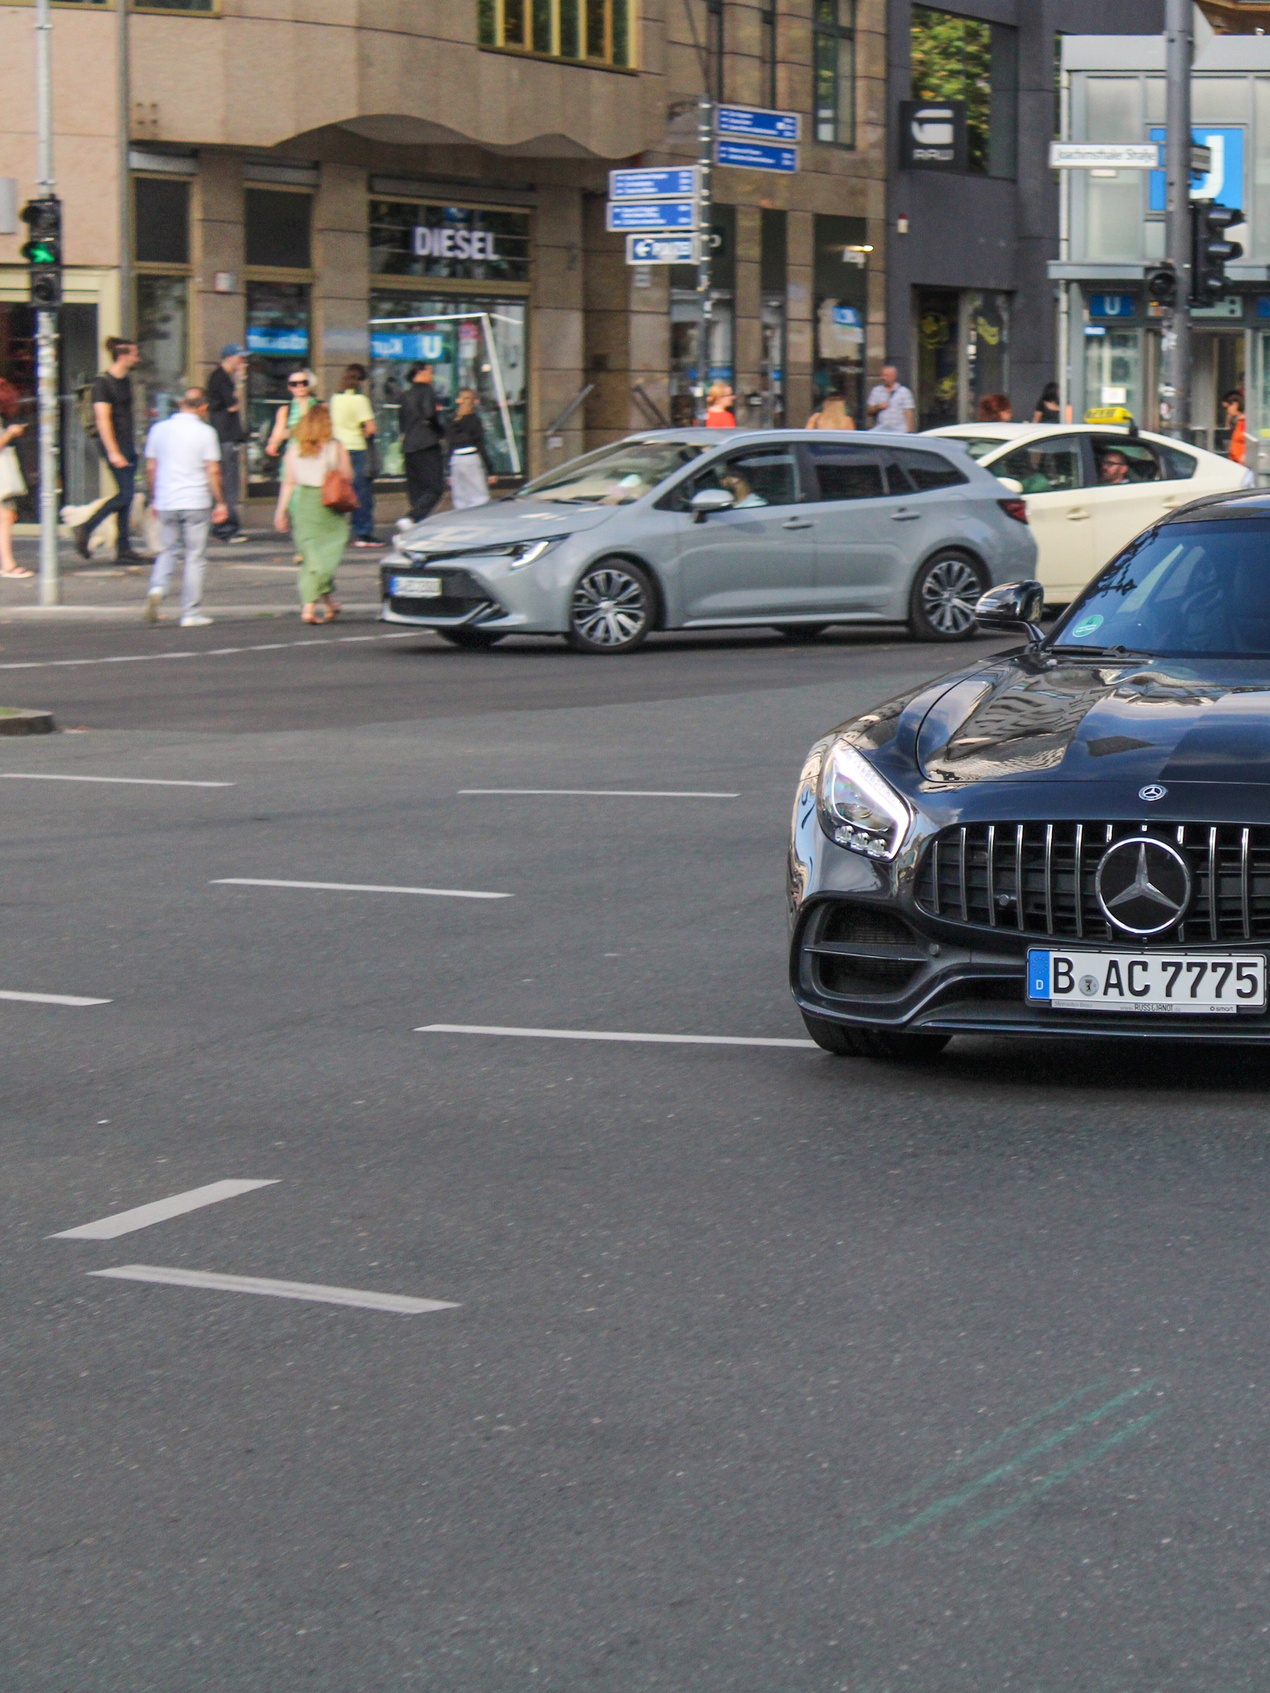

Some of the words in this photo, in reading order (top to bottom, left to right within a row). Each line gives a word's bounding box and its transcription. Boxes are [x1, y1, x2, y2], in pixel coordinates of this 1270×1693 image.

[414, 226, 500, 260] DIESEL
[1104, 297, 1121, 316] U
[1035, 979, 1044, 990] D
[1053, 957, 1075, 994] B
[1103, 959, 1150, 997] AC
[1161, 961, 1258, 998] 7775
